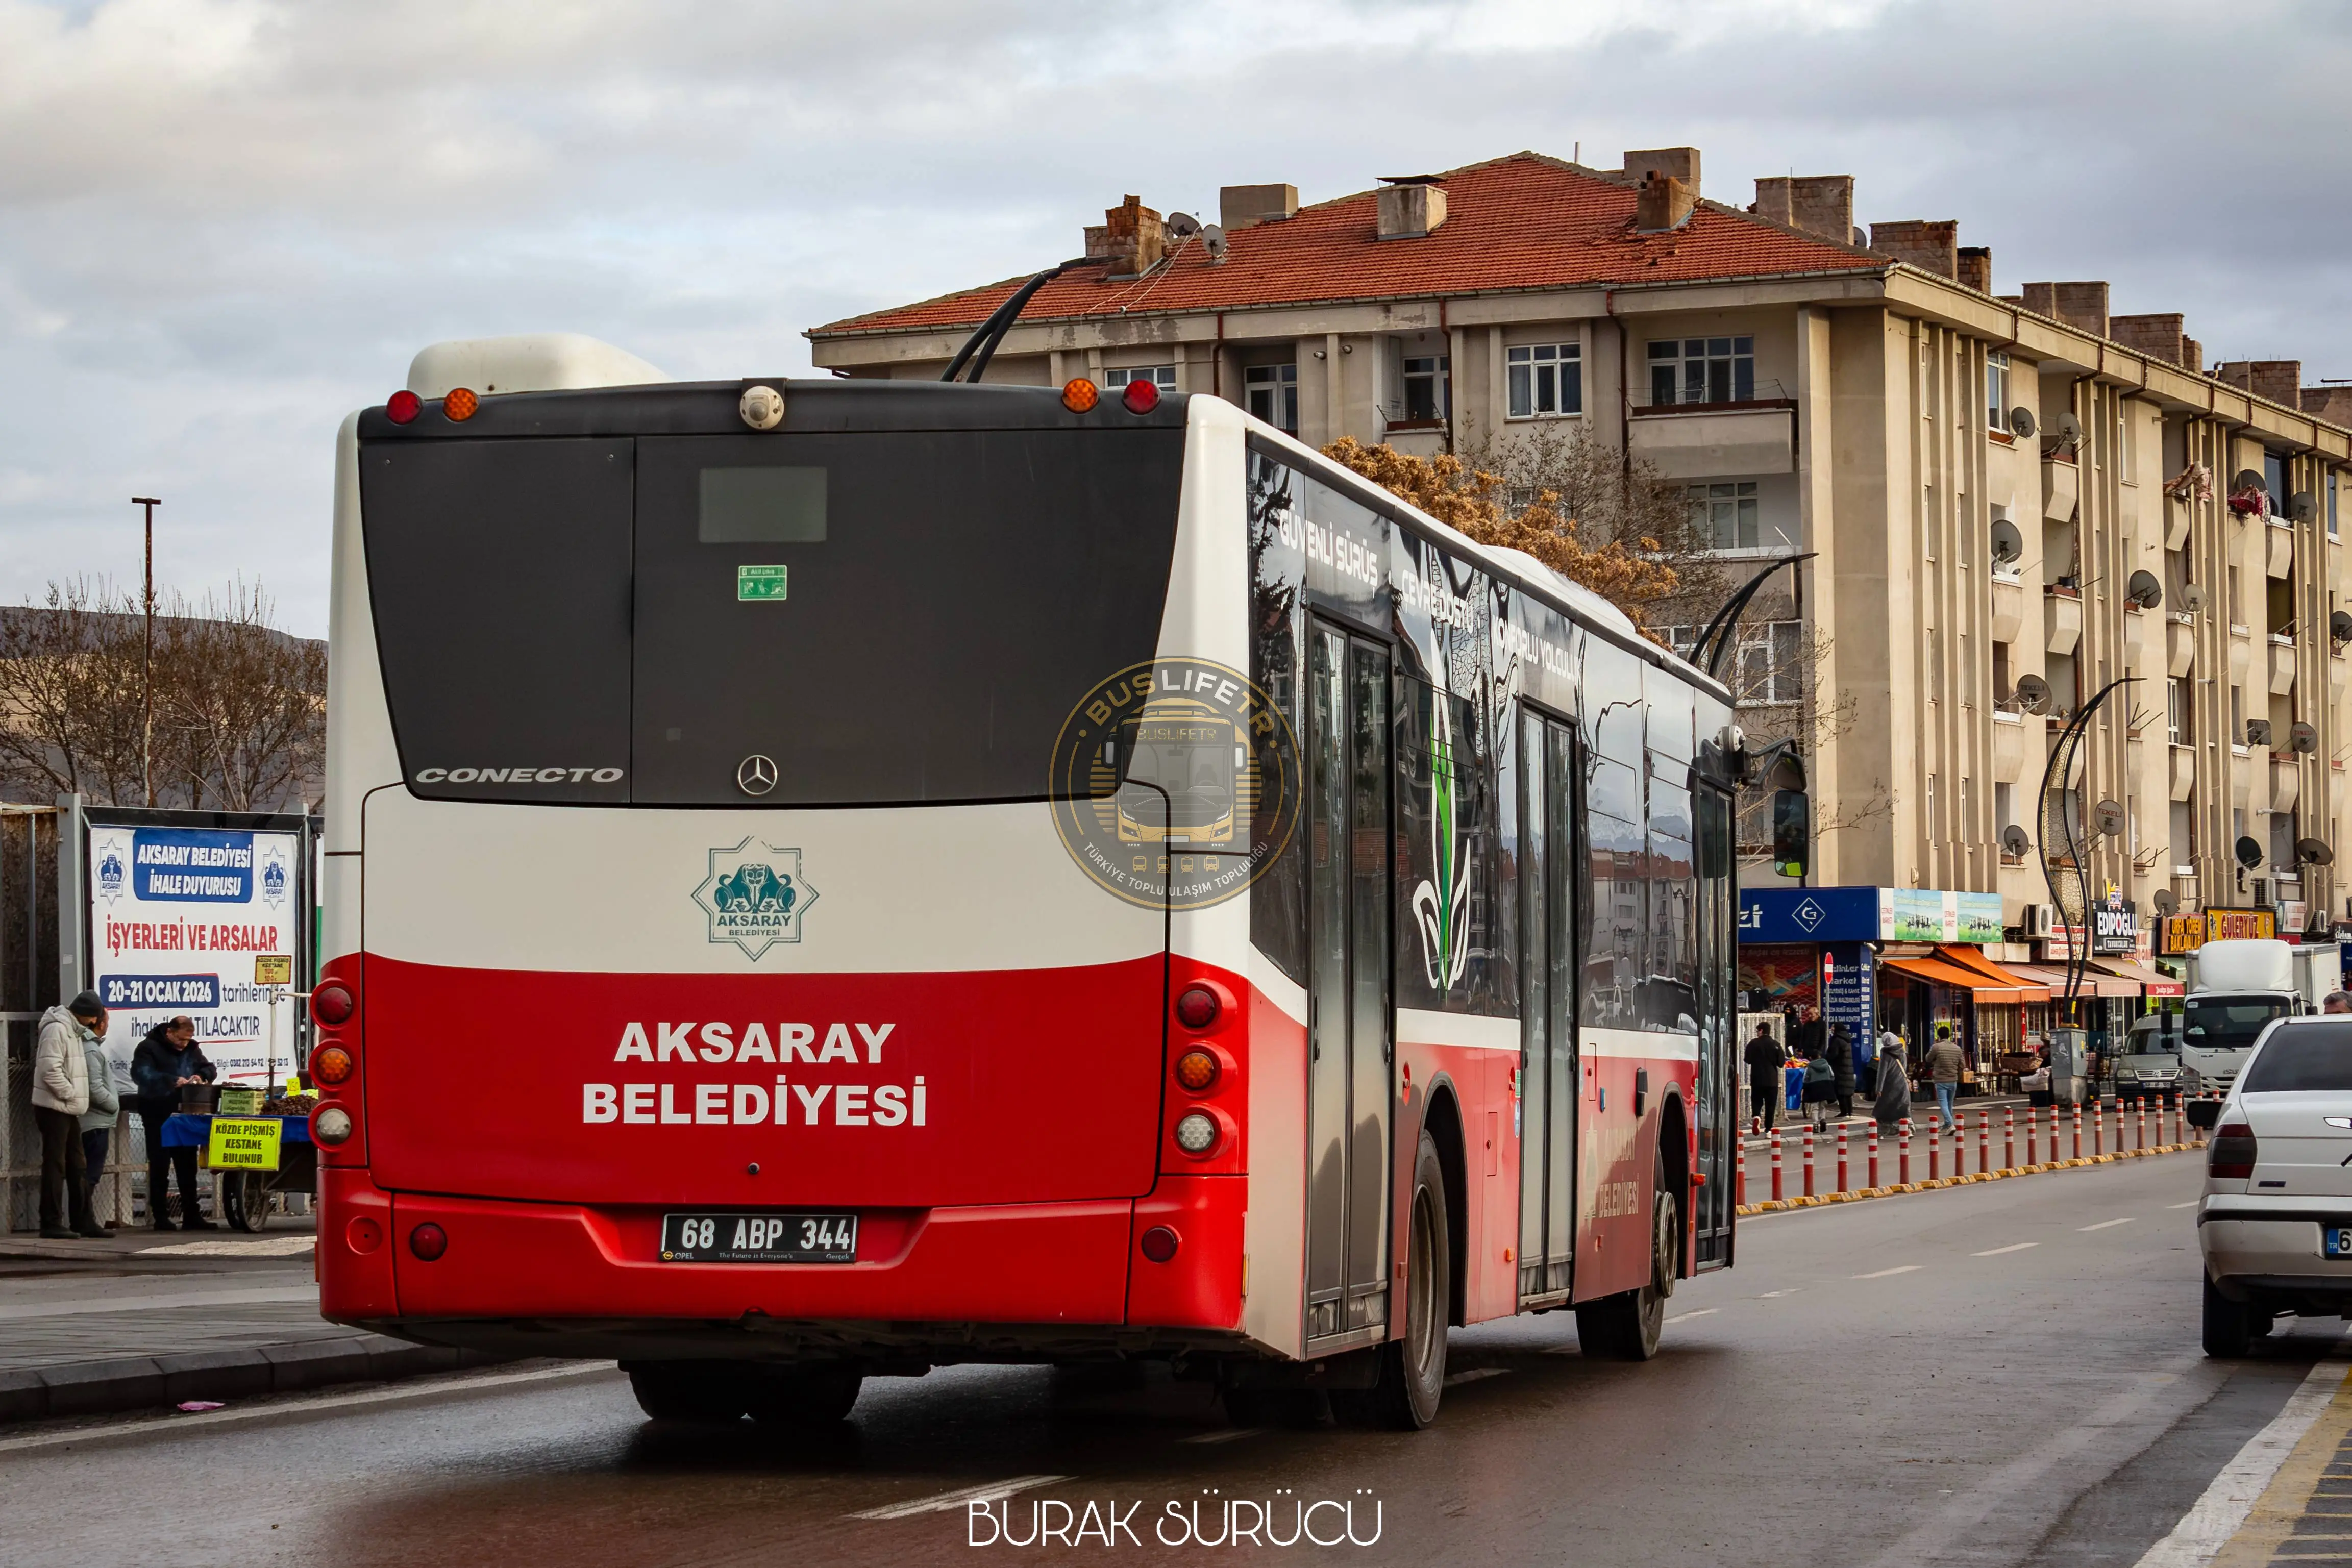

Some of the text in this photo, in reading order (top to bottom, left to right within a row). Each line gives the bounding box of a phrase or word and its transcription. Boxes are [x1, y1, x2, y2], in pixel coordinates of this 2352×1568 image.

[1279, 502, 1378, 599] GÜVENLİ SÜRÜŞ
[1439, 588, 1473, 634] DOSTU
[1492, 614, 1539, 664] KONFORLU
[416, 768, 624, 783] CONECTO
[137, 842, 252, 868] AKSARAY BELEDİYESİ
[149, 869, 241, 897] İHALE DUYURUSU
[717, 915, 792, 926] AKSARAY
[2221, 911, 2260, 940] GÜLERYÜZ
[107, 914, 278, 957] İŞYERLERİ VE ARSALAR
[108, 980, 143, 1003] 20-21
[145, 980, 182, 1002] OCAK
[182, 981, 212, 1003] 2026
[190, 1016, 260, 1036] TILACAKTIR
[613, 1022, 896, 1064] AKSARAY
[584, 1075, 926, 1127] BELEDİYESİ
[215, 1123, 275, 1138] KÖZDE PİŞMİŞ
[225, 1138, 262, 1150] KESTANE
[222, 1153, 263, 1164] BULUNUR
[1599, 1173, 1639, 1218] BELEDİYESİ
[682, 1219, 850, 1250] 68 ABP 344
[2339, 1231, 2352, 1251] 6
